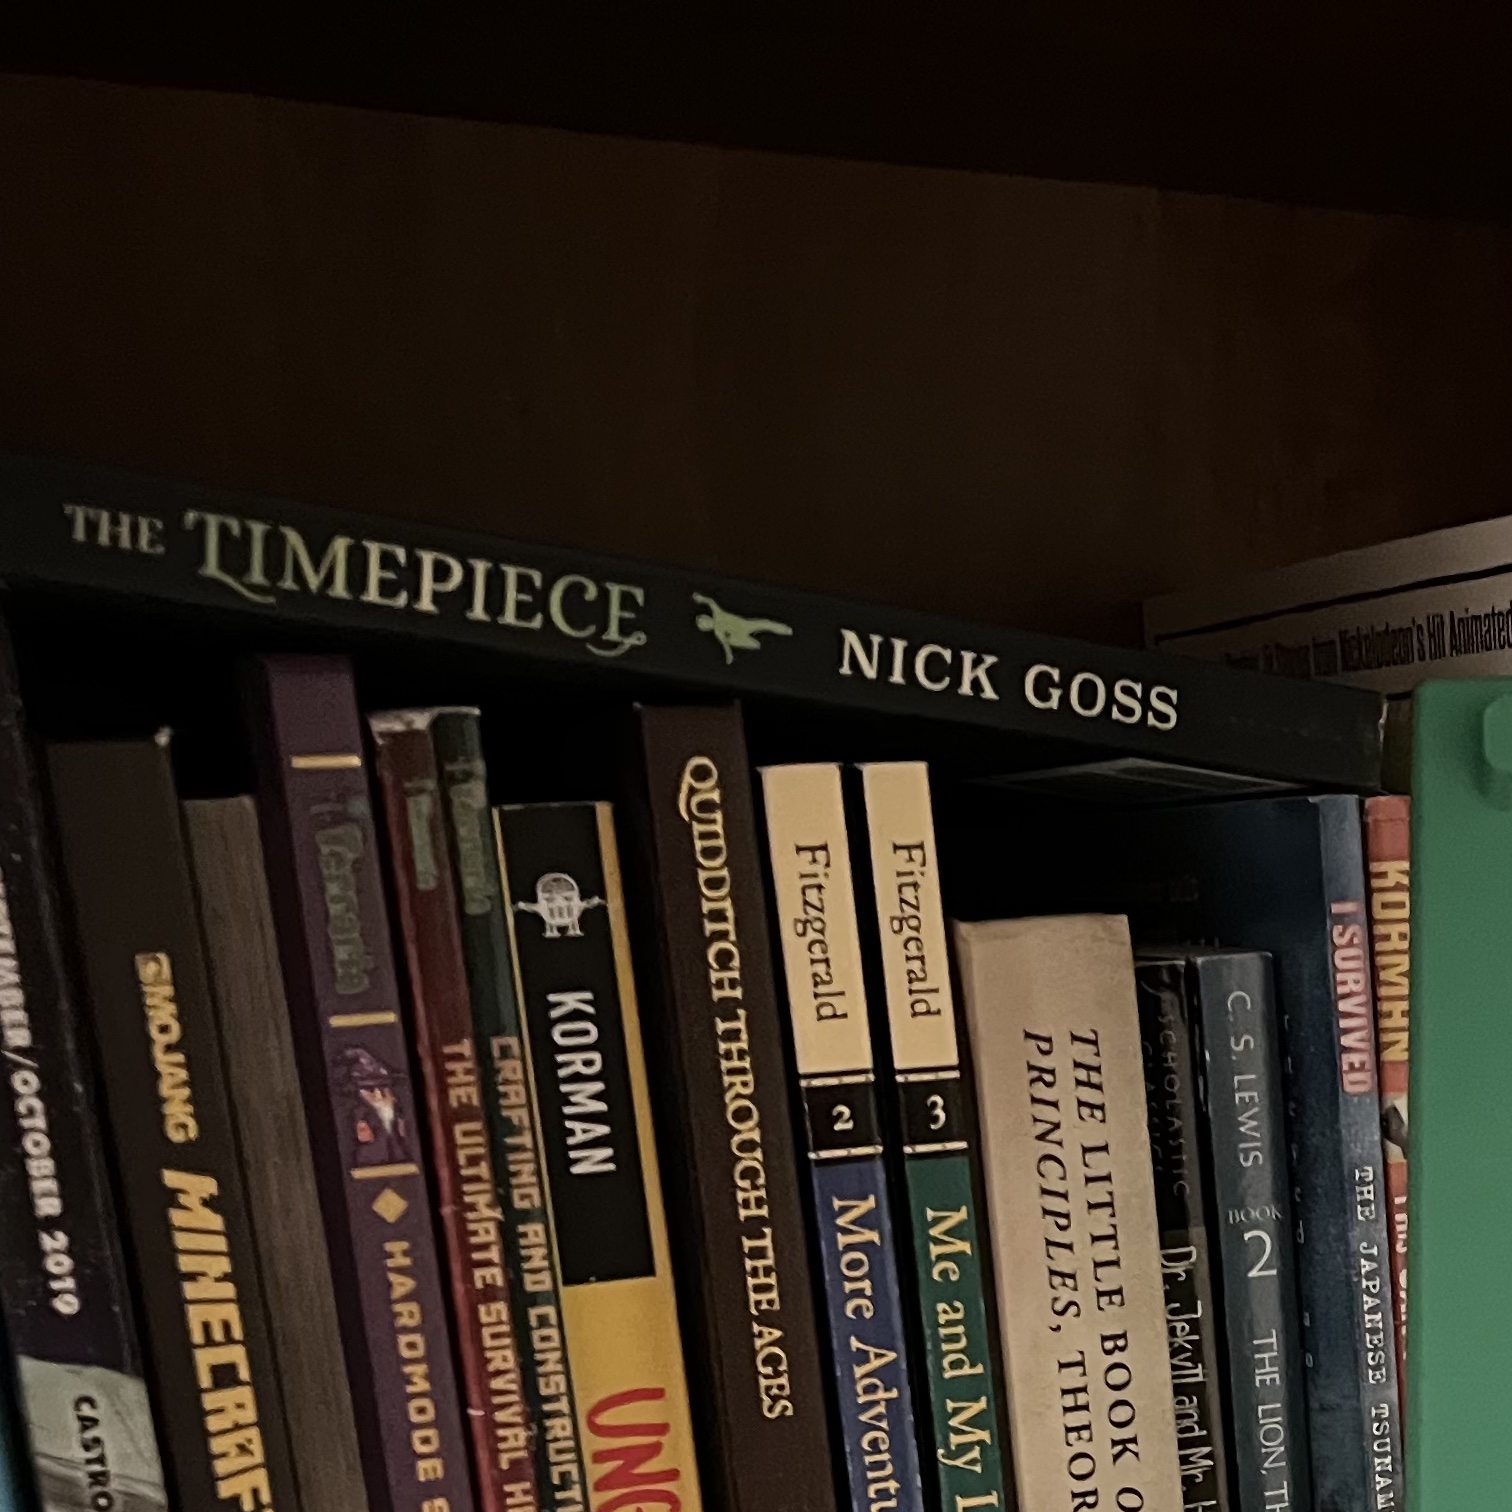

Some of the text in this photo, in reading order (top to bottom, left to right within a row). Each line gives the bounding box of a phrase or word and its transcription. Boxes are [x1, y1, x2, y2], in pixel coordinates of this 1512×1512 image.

[63, 503, 647, 657] THE TIMEPIECE
[839, 628, 1180, 731] NICK GOSS
[793, 842, 848, 1023] Fitzgerald
[889, 840, 943, 1020] Fitzgerald
[1370, 860, 1411, 1064] KORMAN
[1331, 901, 1375, 1094] I SURVIVED
[440, 1037, 481, 1110] THE
[546, 990, 617, 1176] KORMAN
[677, 755, 794, 1421] QUIDDITCH THROUGH THE AGES
[831, 1103, 855, 1132] 2
[927, 1094, 947, 1130] 3
[1070, 1027, 1108, 1127] THE
[1227, 991, 1263, 1168] C. S. LEWIS
[452, 1120, 506, 1292] ULTIMATE
[490, 1036, 541, 1210] CRAFTING
[516, 1224, 552, 1294] AND
[1022, 1027, 1084, 1335] PRINCIPLES,
[1080, 1140, 1127, 1314] LITTLE
[1228, 1206, 1284, 1226] BOOK
[1354, 1166, 1377, 1222] THE
[38, 1229, 82, 1319] 2019
[831, 1193, 881, 1321] More
[925, 1205, 973, 1284] Me
[1243, 1230, 1278, 1279] 2
[382, 1240, 447, 1484] HARDMODE
[935, 1300, 985, 1380] and
[1252, 1330, 1281, 1388] THE
[1359, 1241, 1388, 1385] JAPANESE
[477, 1301, 529, 1471] SURVIVAL
[938, 1396, 993, 1474] My
[1099, 1329, 1143, 1467] BOOK
[1175, 1395, 1209, 1440] and
[1257, 1402, 1289, 1476] LION,
[76, 1394, 115, 1512] CASTRO
